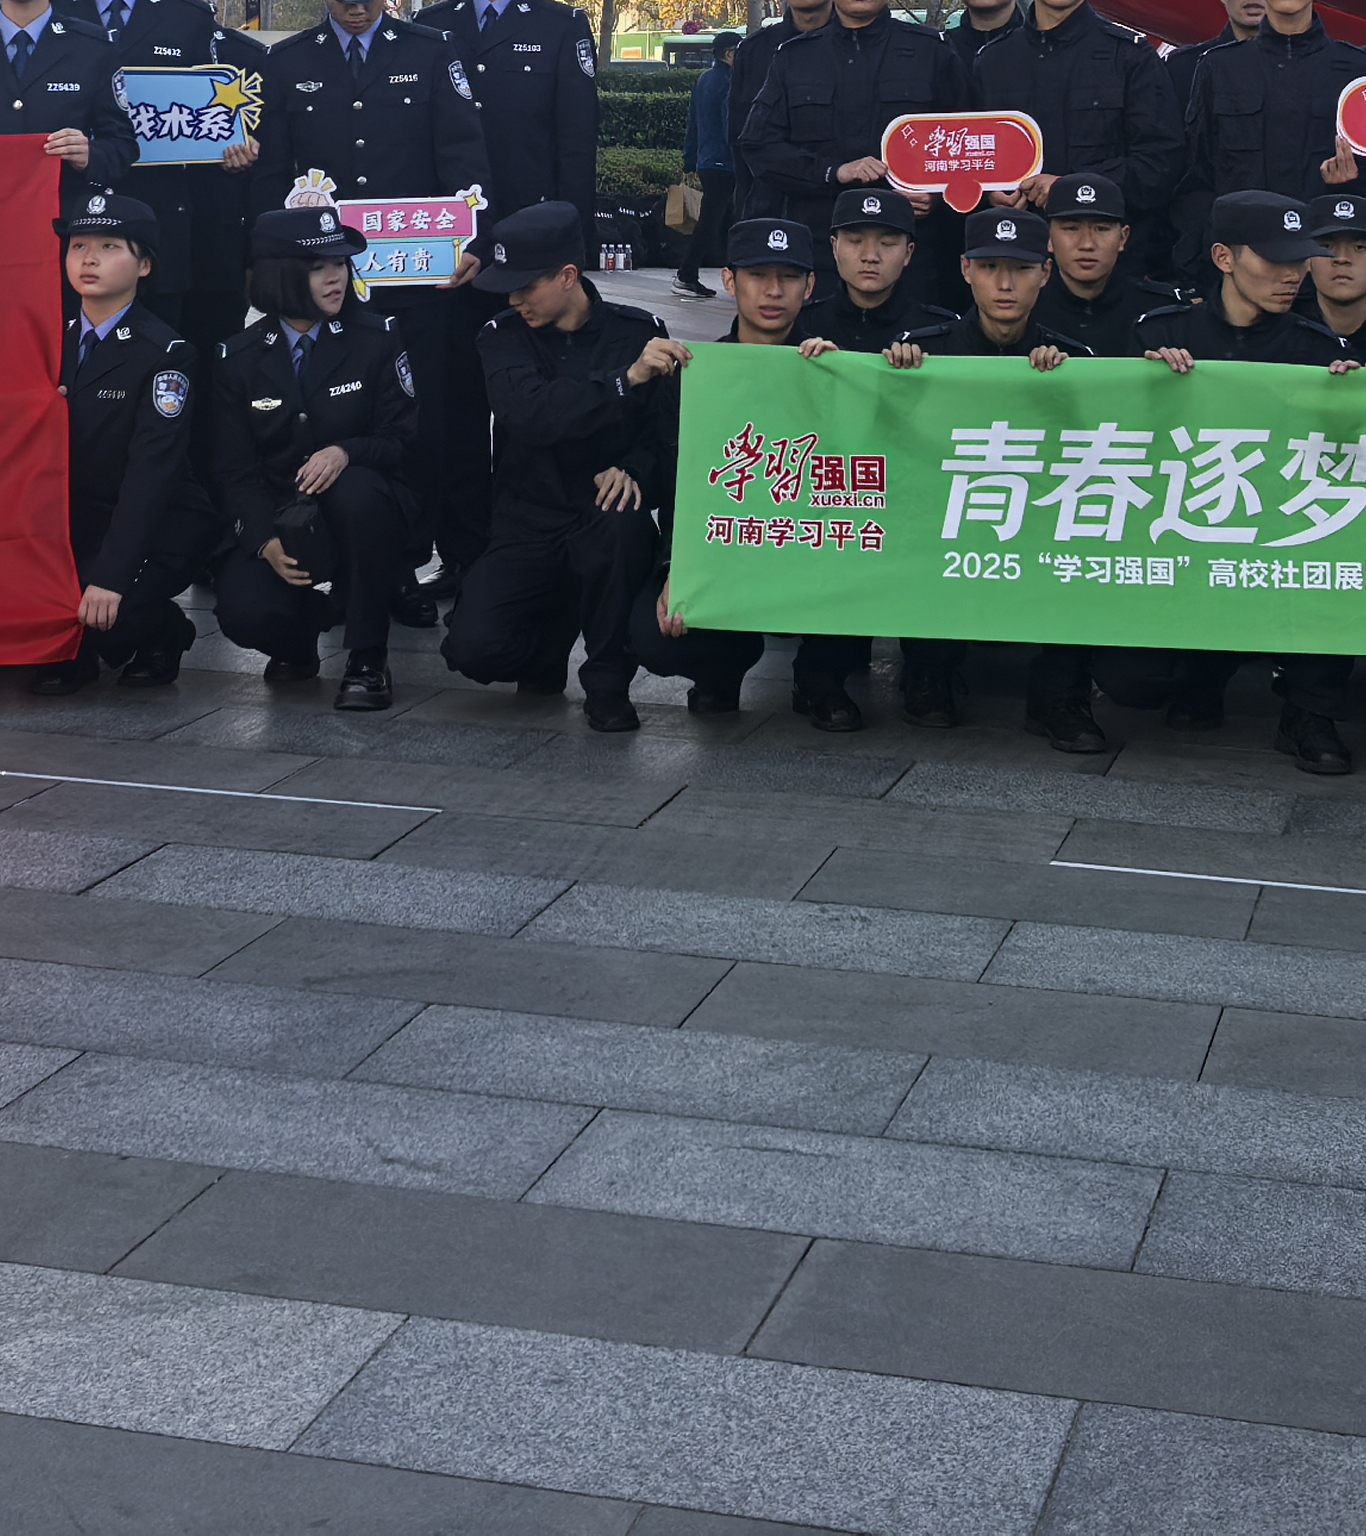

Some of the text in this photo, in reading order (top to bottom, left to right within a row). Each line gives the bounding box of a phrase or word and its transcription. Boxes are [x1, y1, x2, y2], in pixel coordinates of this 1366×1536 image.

[924, 158, 995, 172] 河南学习平台
[362, 208, 458, 233] 国家安全
[808, 492, 887, 509] xuexi.cn
[706, 514, 886, 551] 河南学习平台
[942, 551, 1022, 581] 2025
